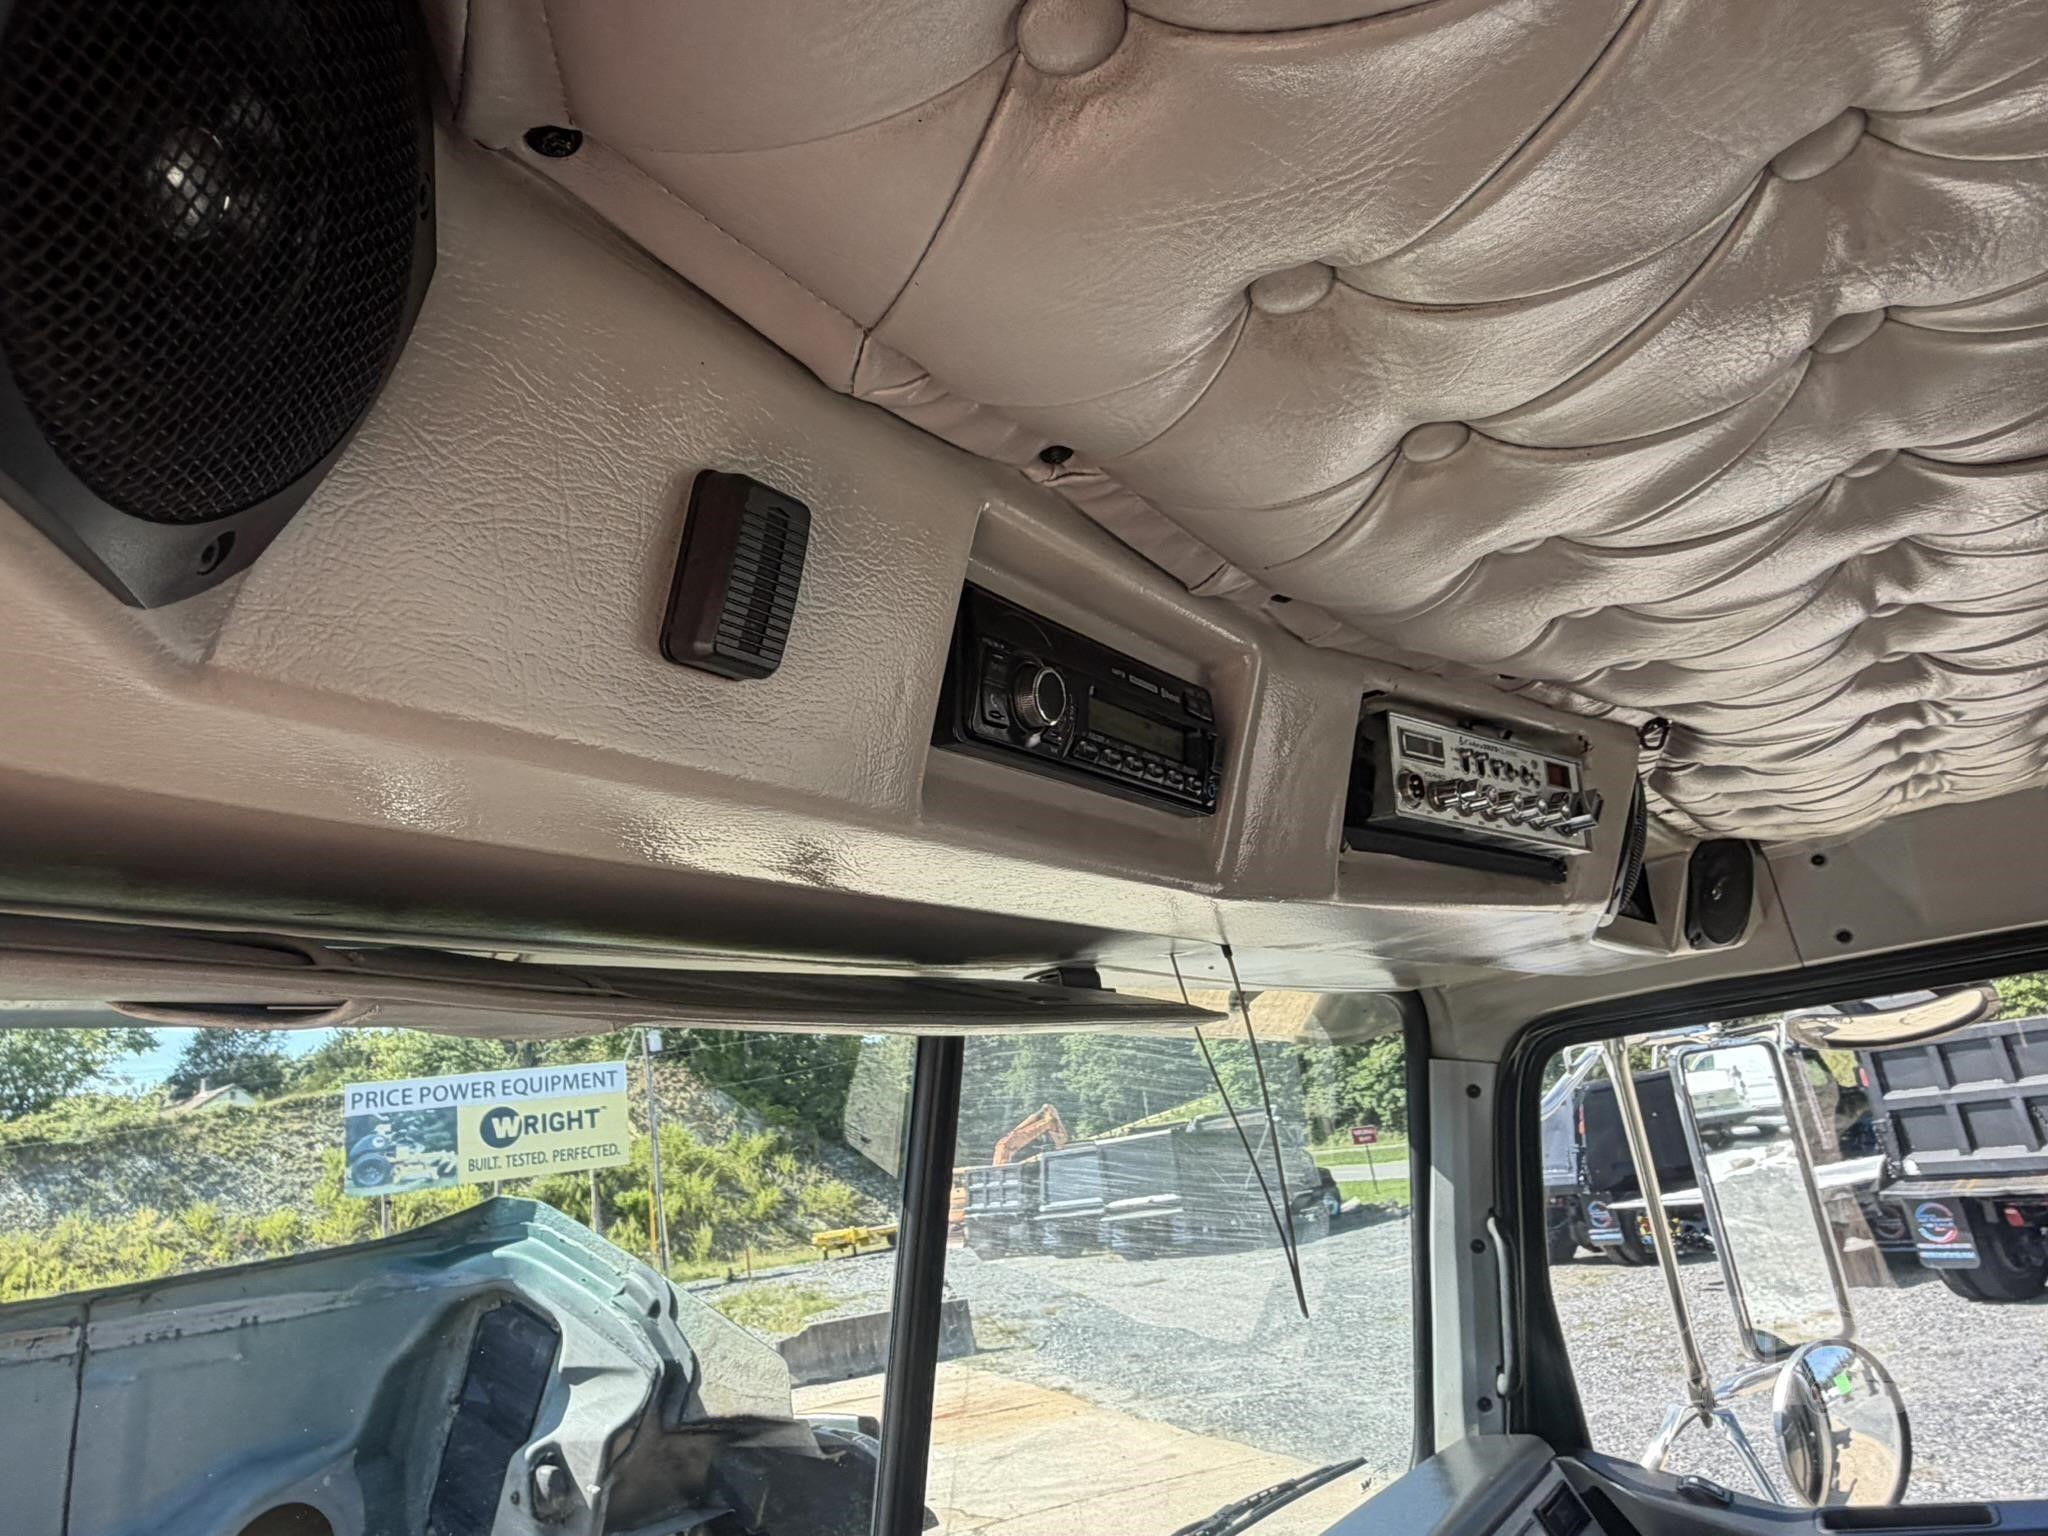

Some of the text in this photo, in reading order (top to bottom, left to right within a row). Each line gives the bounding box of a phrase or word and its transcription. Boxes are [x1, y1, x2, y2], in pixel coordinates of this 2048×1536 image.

[351, 1070, 618, 1110] PRICE POWER EQUIPMENT
[491, 1108, 600, 1140] WRIGHT
[468, 1143, 620, 1173] BUILT. TESTED. PERFECTED.
